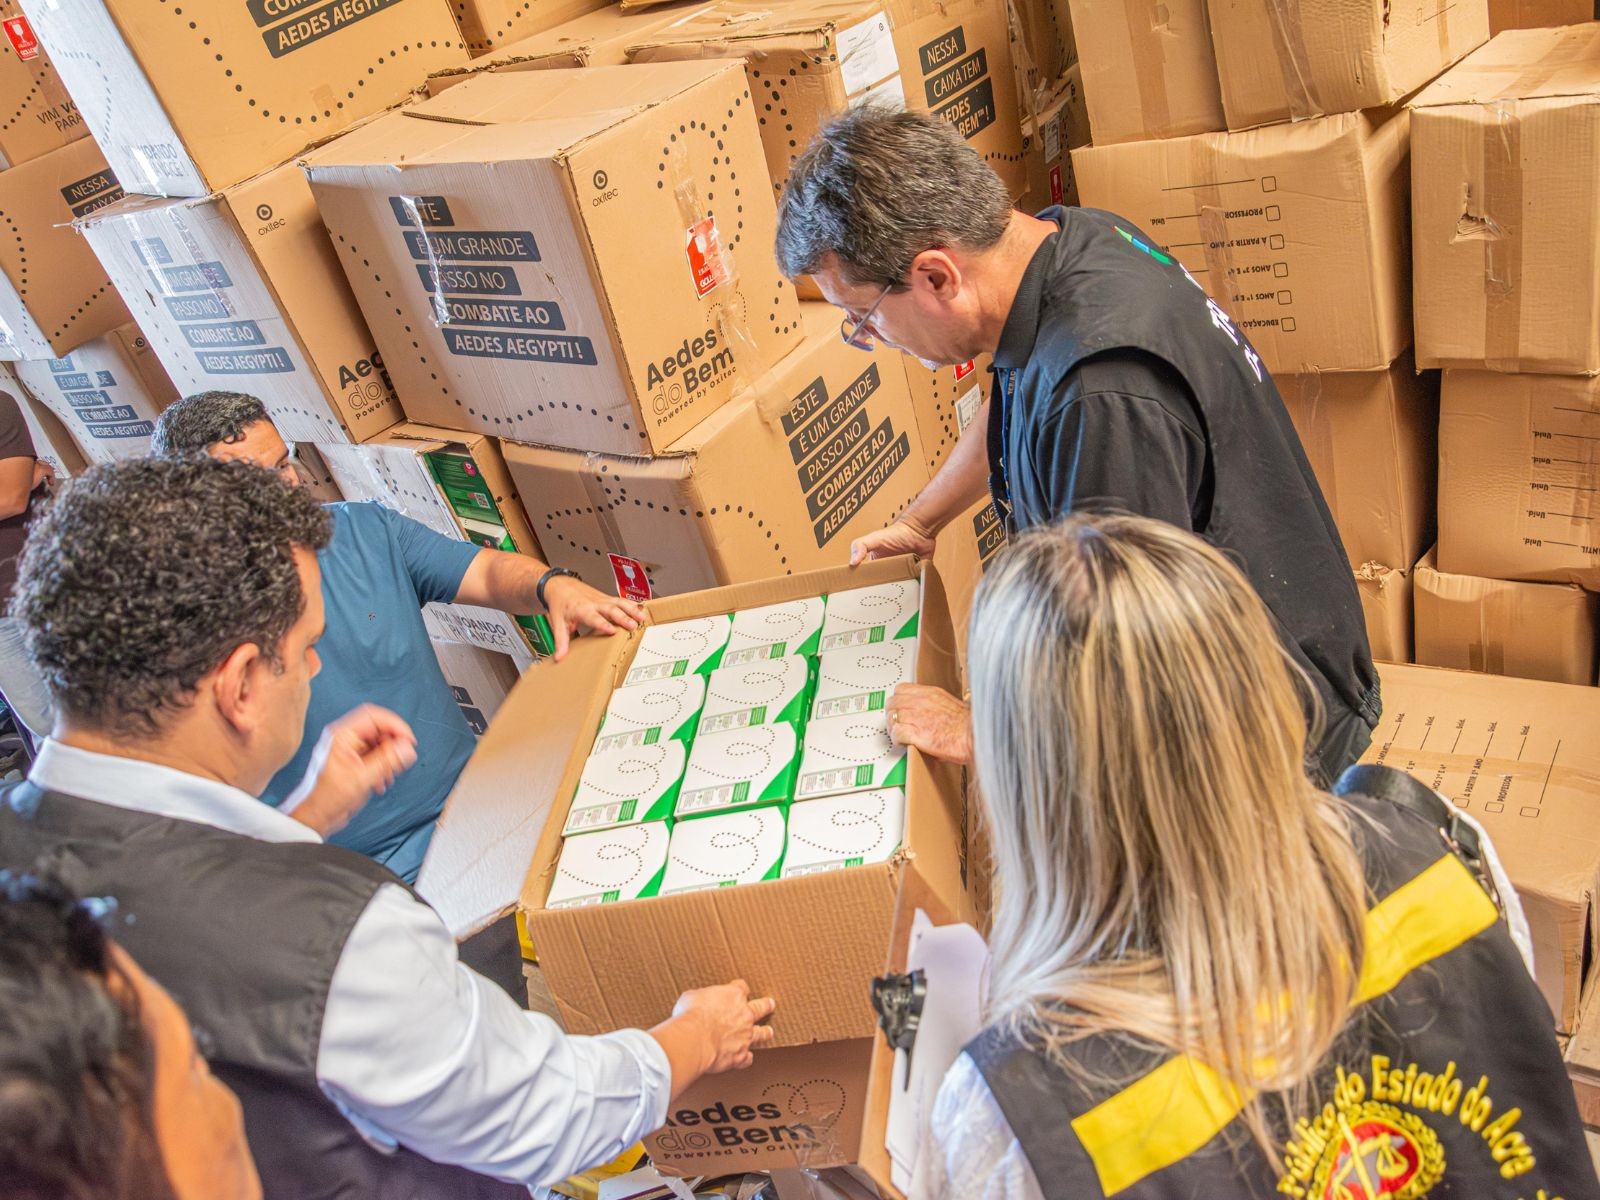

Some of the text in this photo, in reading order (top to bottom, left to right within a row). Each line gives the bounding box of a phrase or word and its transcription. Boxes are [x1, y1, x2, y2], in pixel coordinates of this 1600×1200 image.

[278, 12, 330, 50] AEDES
[333, 0, 389, 26] AEG
[927, 36, 959, 67] NESSA
[933, 56, 980, 98] CAIXA TEM
[36, 109, 61, 125] VIM
[71, 175, 110, 200] NESSA
[592, 187, 619, 207] oxitec
[402, 202, 441, 221] ETE
[1224, 207, 1263, 219] PROFESSOR
[258, 217, 286, 237] oxitec
[457, 237, 528, 256] GRANDE
[1236, 237, 1260, 247] PARTIR
[479, 271, 506, 290] NO
[172, 299, 219, 317] PASSO NO
[525, 306, 550, 325] AO
[188, 326, 254, 343] COMBATE AO
[1242, 320, 1279, 330] EDUCAÇÃO
[454, 334, 504, 354] AEDES
[54, 358, 71, 370] ESTE
[204, 354, 235, 371] AEDES
[647, 328, 718, 392] Aedes
[652, 347, 735, 416] do Bem
[348, 382, 382, 411] do
[696, 387, 707, 399] by
[118, 409, 130, 420] AO
[790, 388, 820, 425] ESTE
[799, 373, 873, 454] É UM GRANDE
[92, 427, 113, 437] AEDES
[807, 420, 862, 482] PASSO NO
[816, 428, 886, 508] COMBATE AO
[1530, 482, 1549, 491] Unid.
[823, 491, 859, 539] AEDES
[1526, 510, 1546, 519] Unid.
[986, 523, 1005, 549] CAI
[1522, 537, 1600, 555] NTIL Unid.
[452, 613, 507, 637] VOANDO
[1497, 775, 1513, 802] PROFESSOR
[1334, 1064, 1366, 1111] do
[1371, 1054, 1463, 1117] Estado
[1459, 1075, 1493, 1132] do
[656, 1123, 817, 1152] do Bem
[740, 1146, 759, 1155] by
